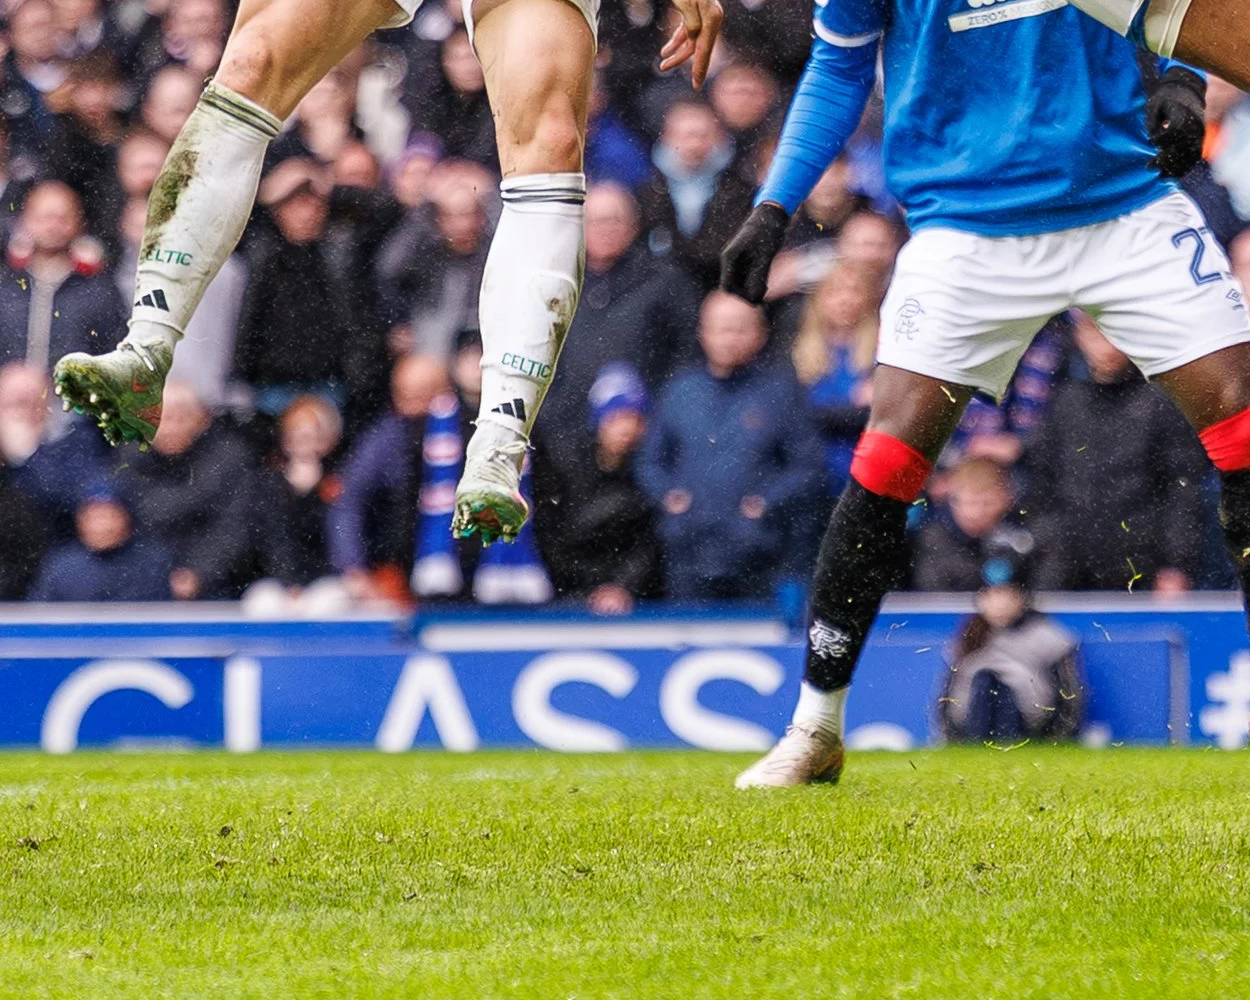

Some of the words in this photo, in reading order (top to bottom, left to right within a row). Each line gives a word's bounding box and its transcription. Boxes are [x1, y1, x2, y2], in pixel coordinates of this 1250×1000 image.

[143, 249, 193, 267] ELTIC
[1171, 227, 1233, 285] 2
[501, 352, 551, 378] CELTIC
